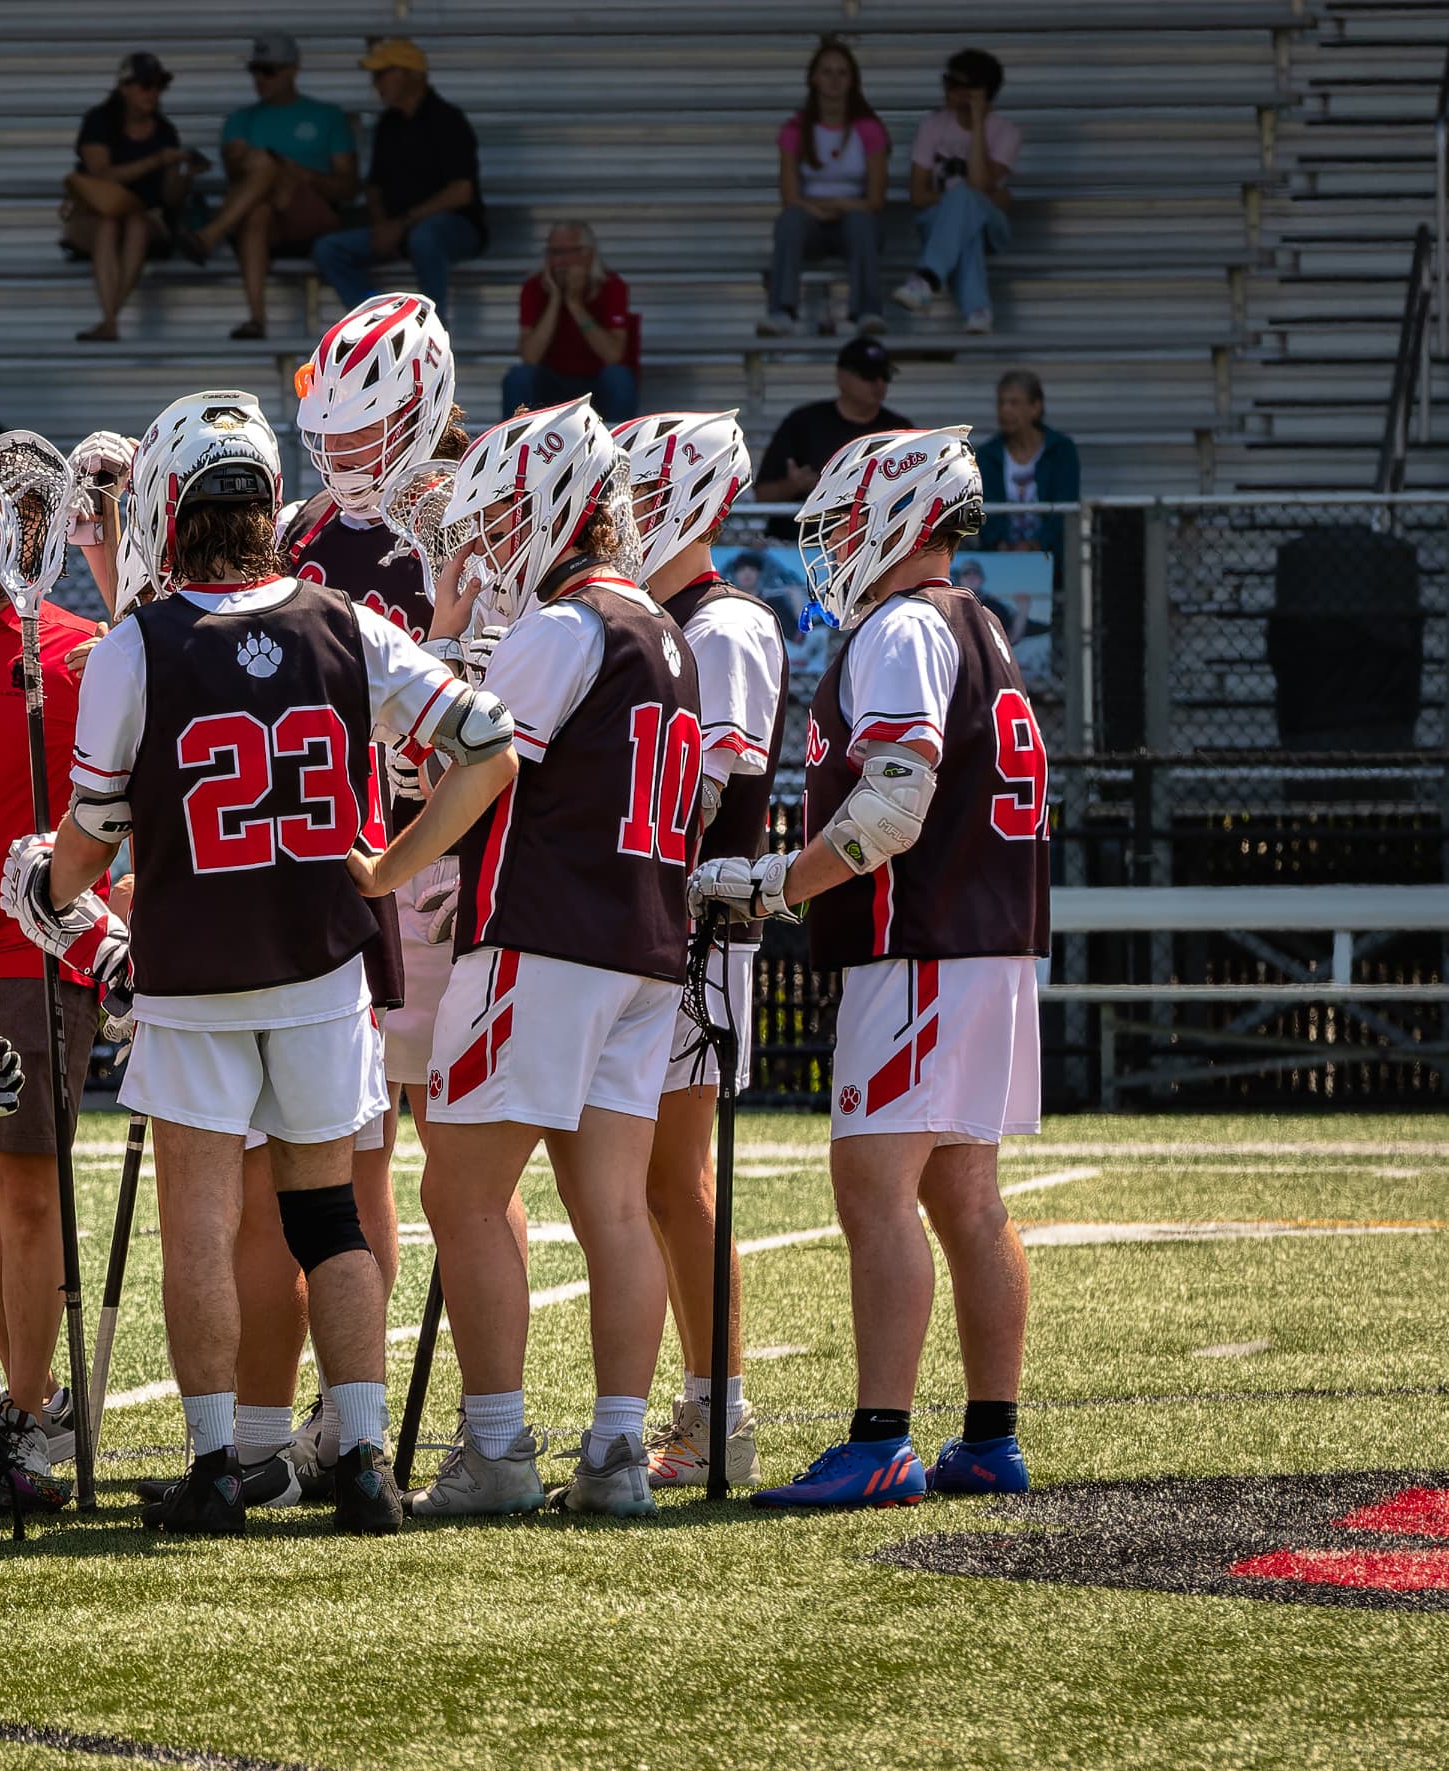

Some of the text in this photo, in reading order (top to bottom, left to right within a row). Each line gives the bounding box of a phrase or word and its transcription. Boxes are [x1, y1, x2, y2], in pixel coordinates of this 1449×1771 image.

[424, 335, 443, 370] 77
[533, 431, 565, 465] 10
[682, 442, 705, 465] 2
[878, 451, 928, 481] Cats
[990, 687, 1051, 842] 9
[176, 704, 362, 874] 23
[616, 701, 704, 867] 10
